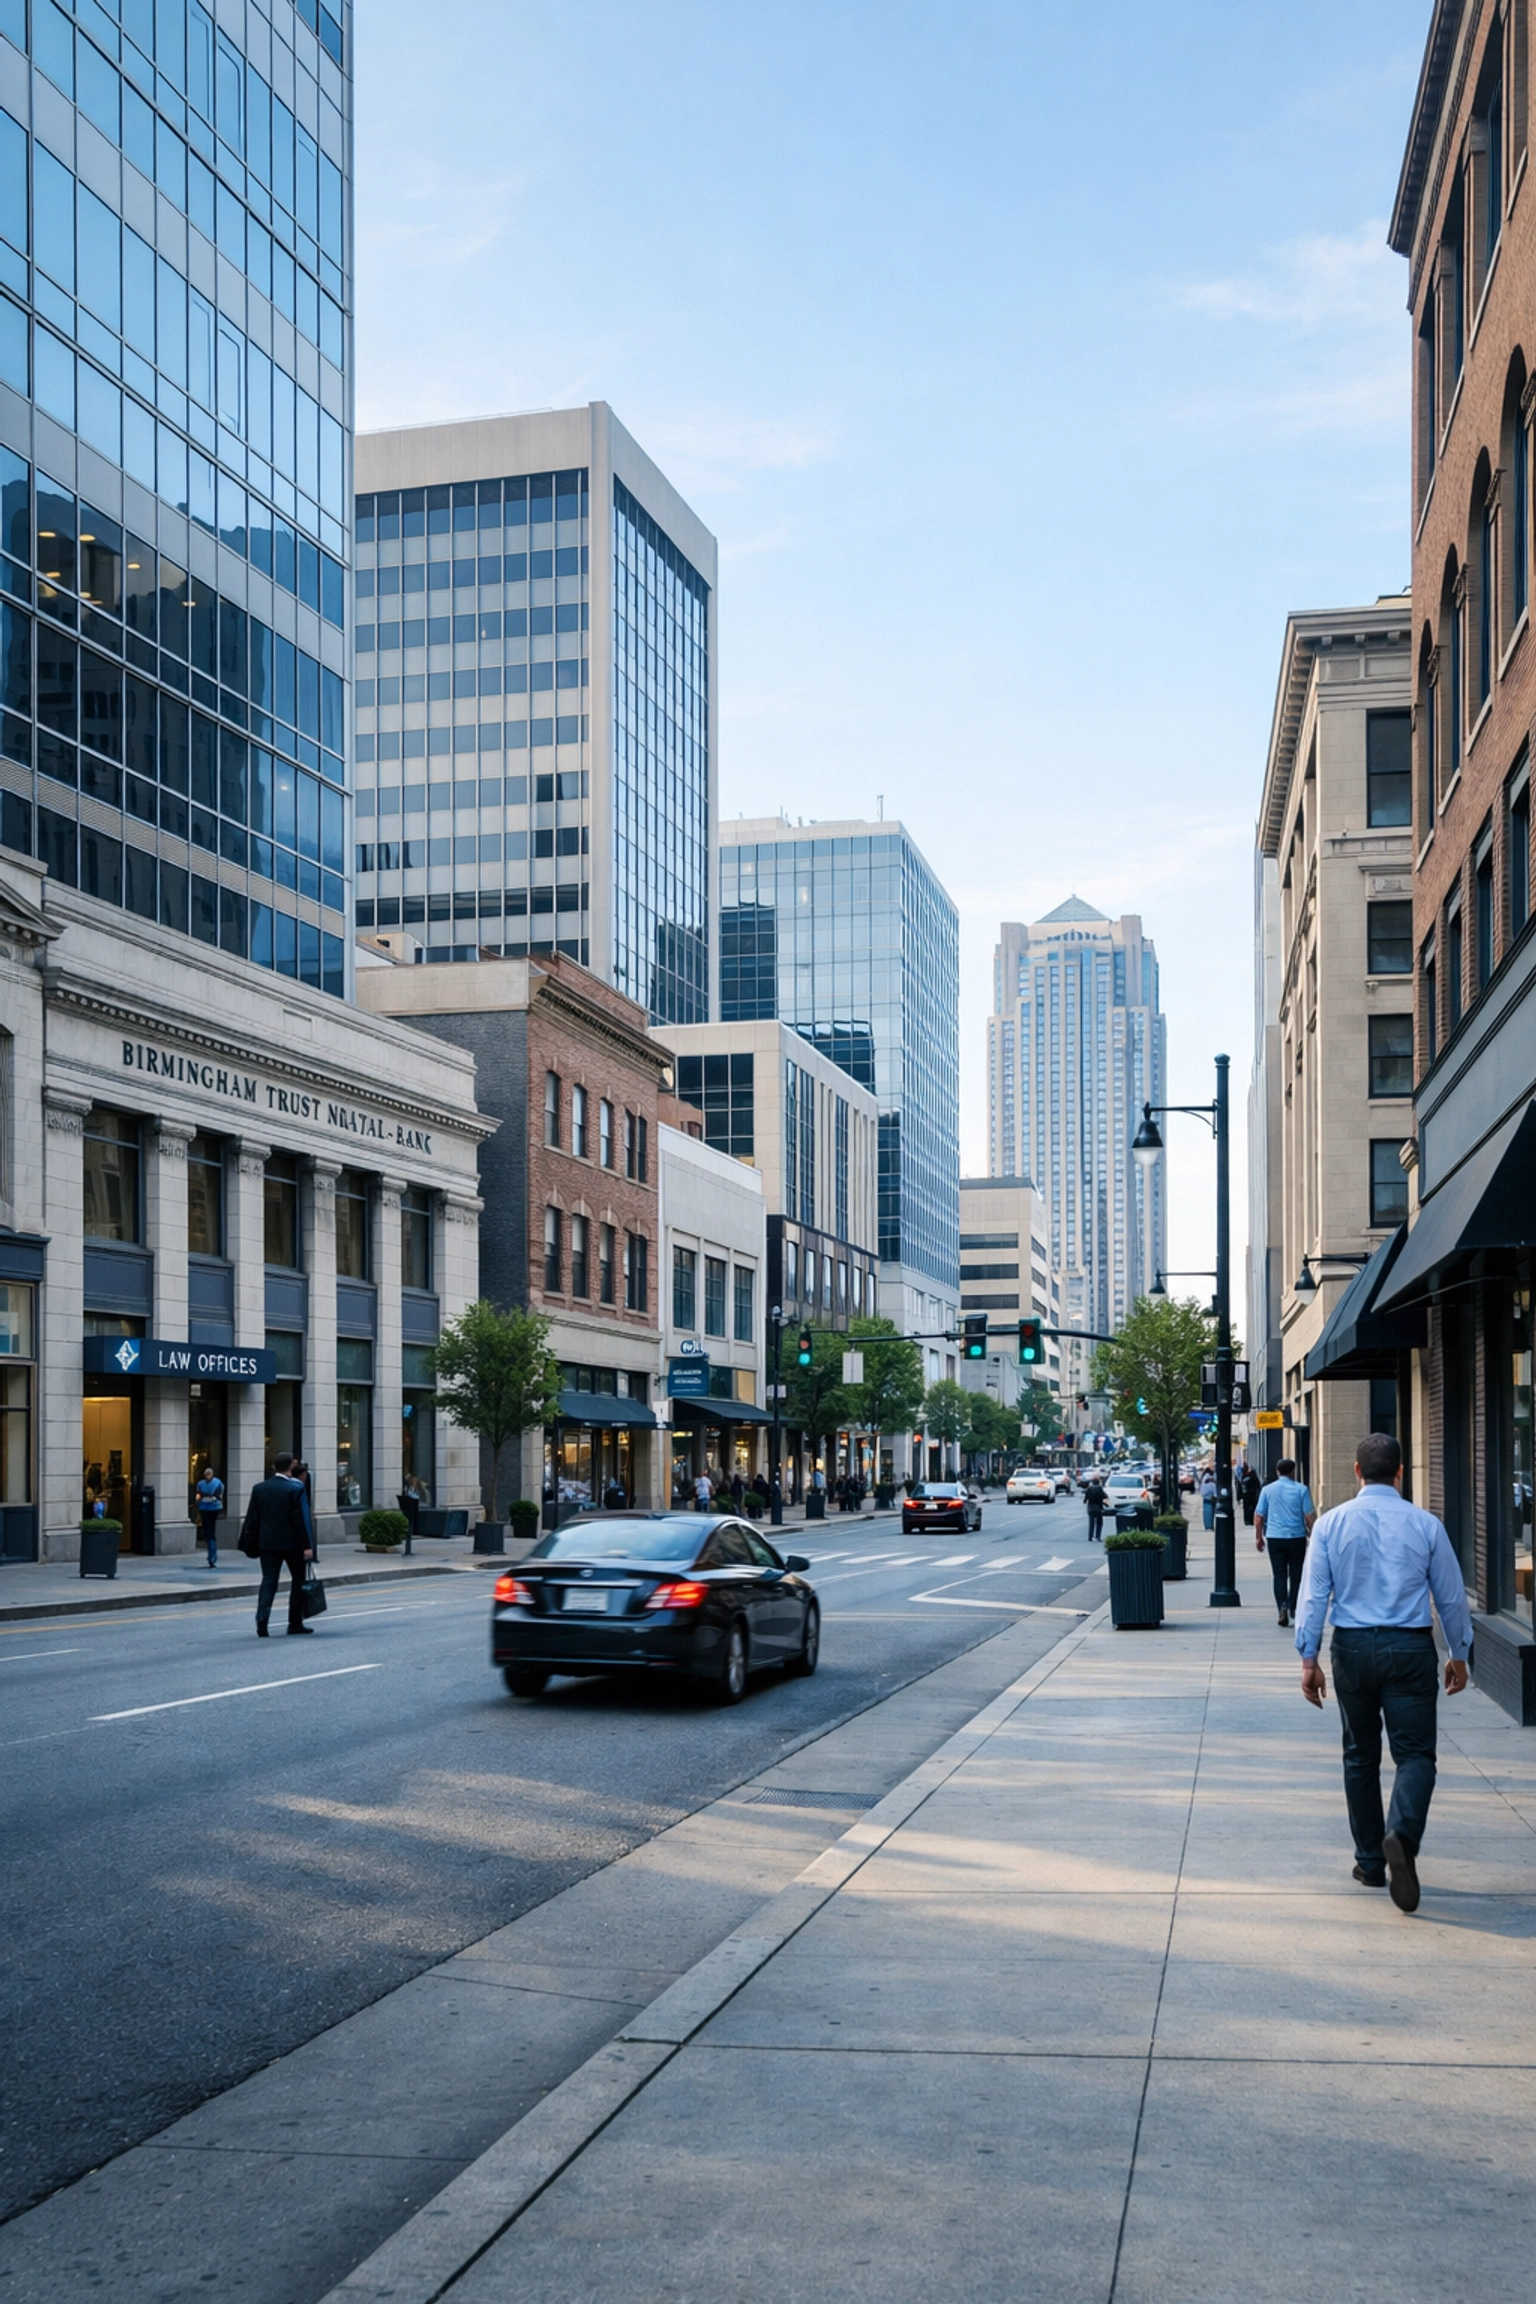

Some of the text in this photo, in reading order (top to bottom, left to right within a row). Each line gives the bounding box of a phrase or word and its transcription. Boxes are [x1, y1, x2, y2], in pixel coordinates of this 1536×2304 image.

[122, 1040, 257, 1102] BIRMINGHAM
[266, 1085, 321, 1121] TRUST
[158, 1350, 258, 1375] LAW OFFICES
